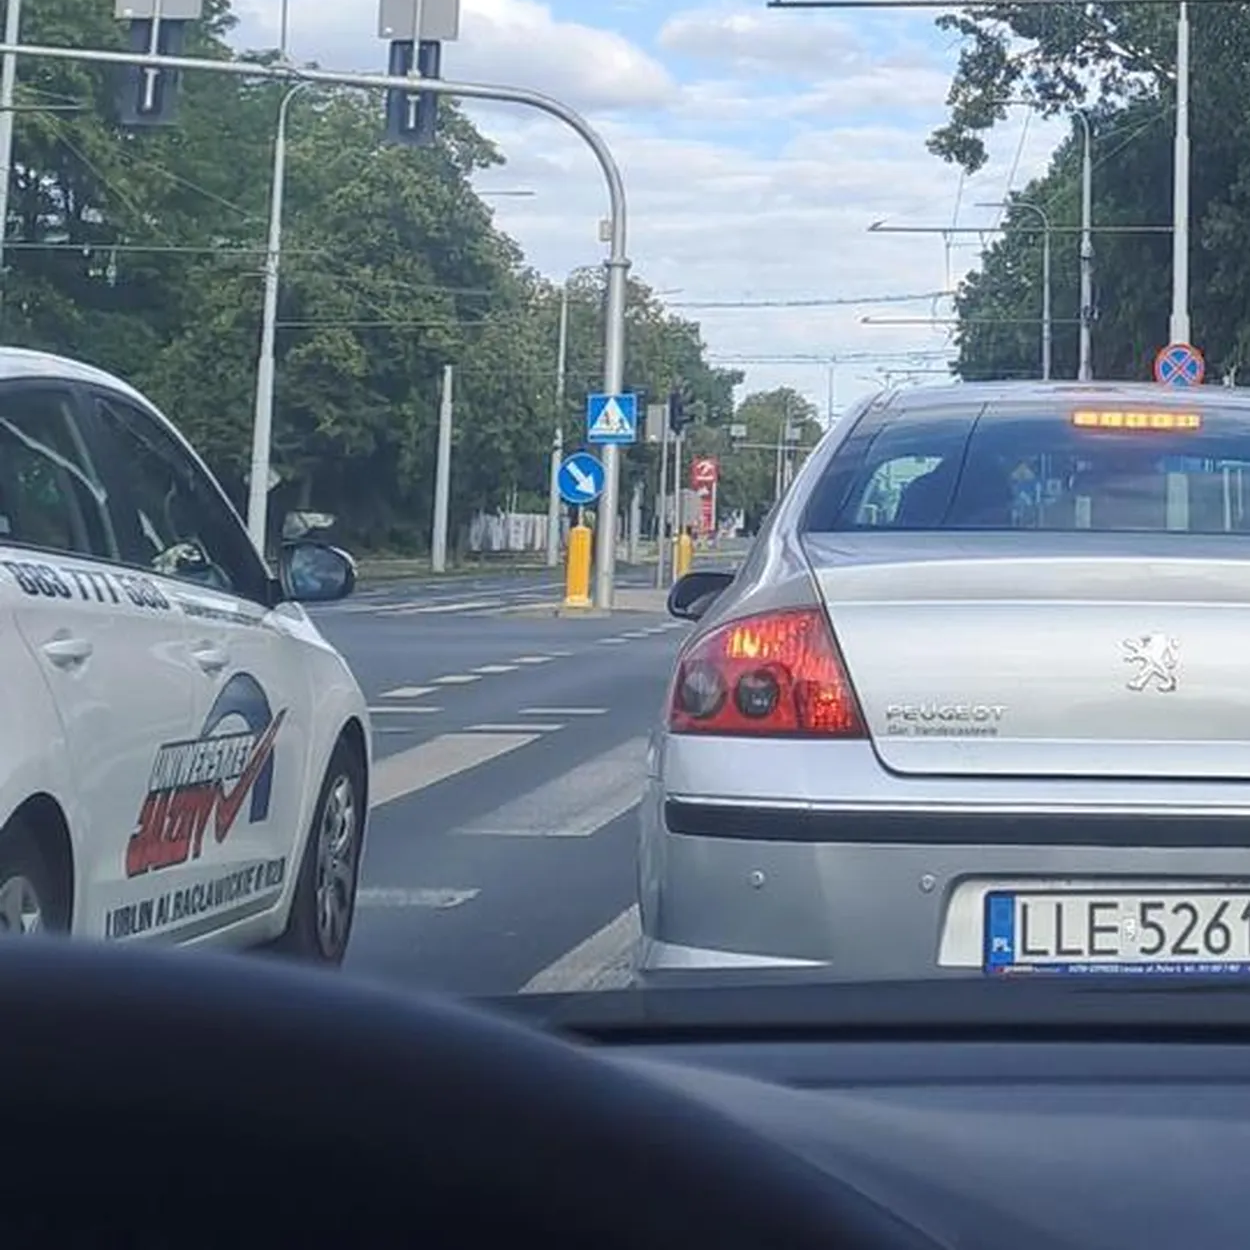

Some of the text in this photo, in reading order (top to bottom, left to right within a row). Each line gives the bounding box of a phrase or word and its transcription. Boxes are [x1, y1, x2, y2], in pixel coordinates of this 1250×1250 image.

[886, 704, 1008, 721] PEUGEOT
[106, 899, 154, 937] LUBLIN
[1021, 901, 1119, 956] LLE
[992, 937, 1011, 952] PL
